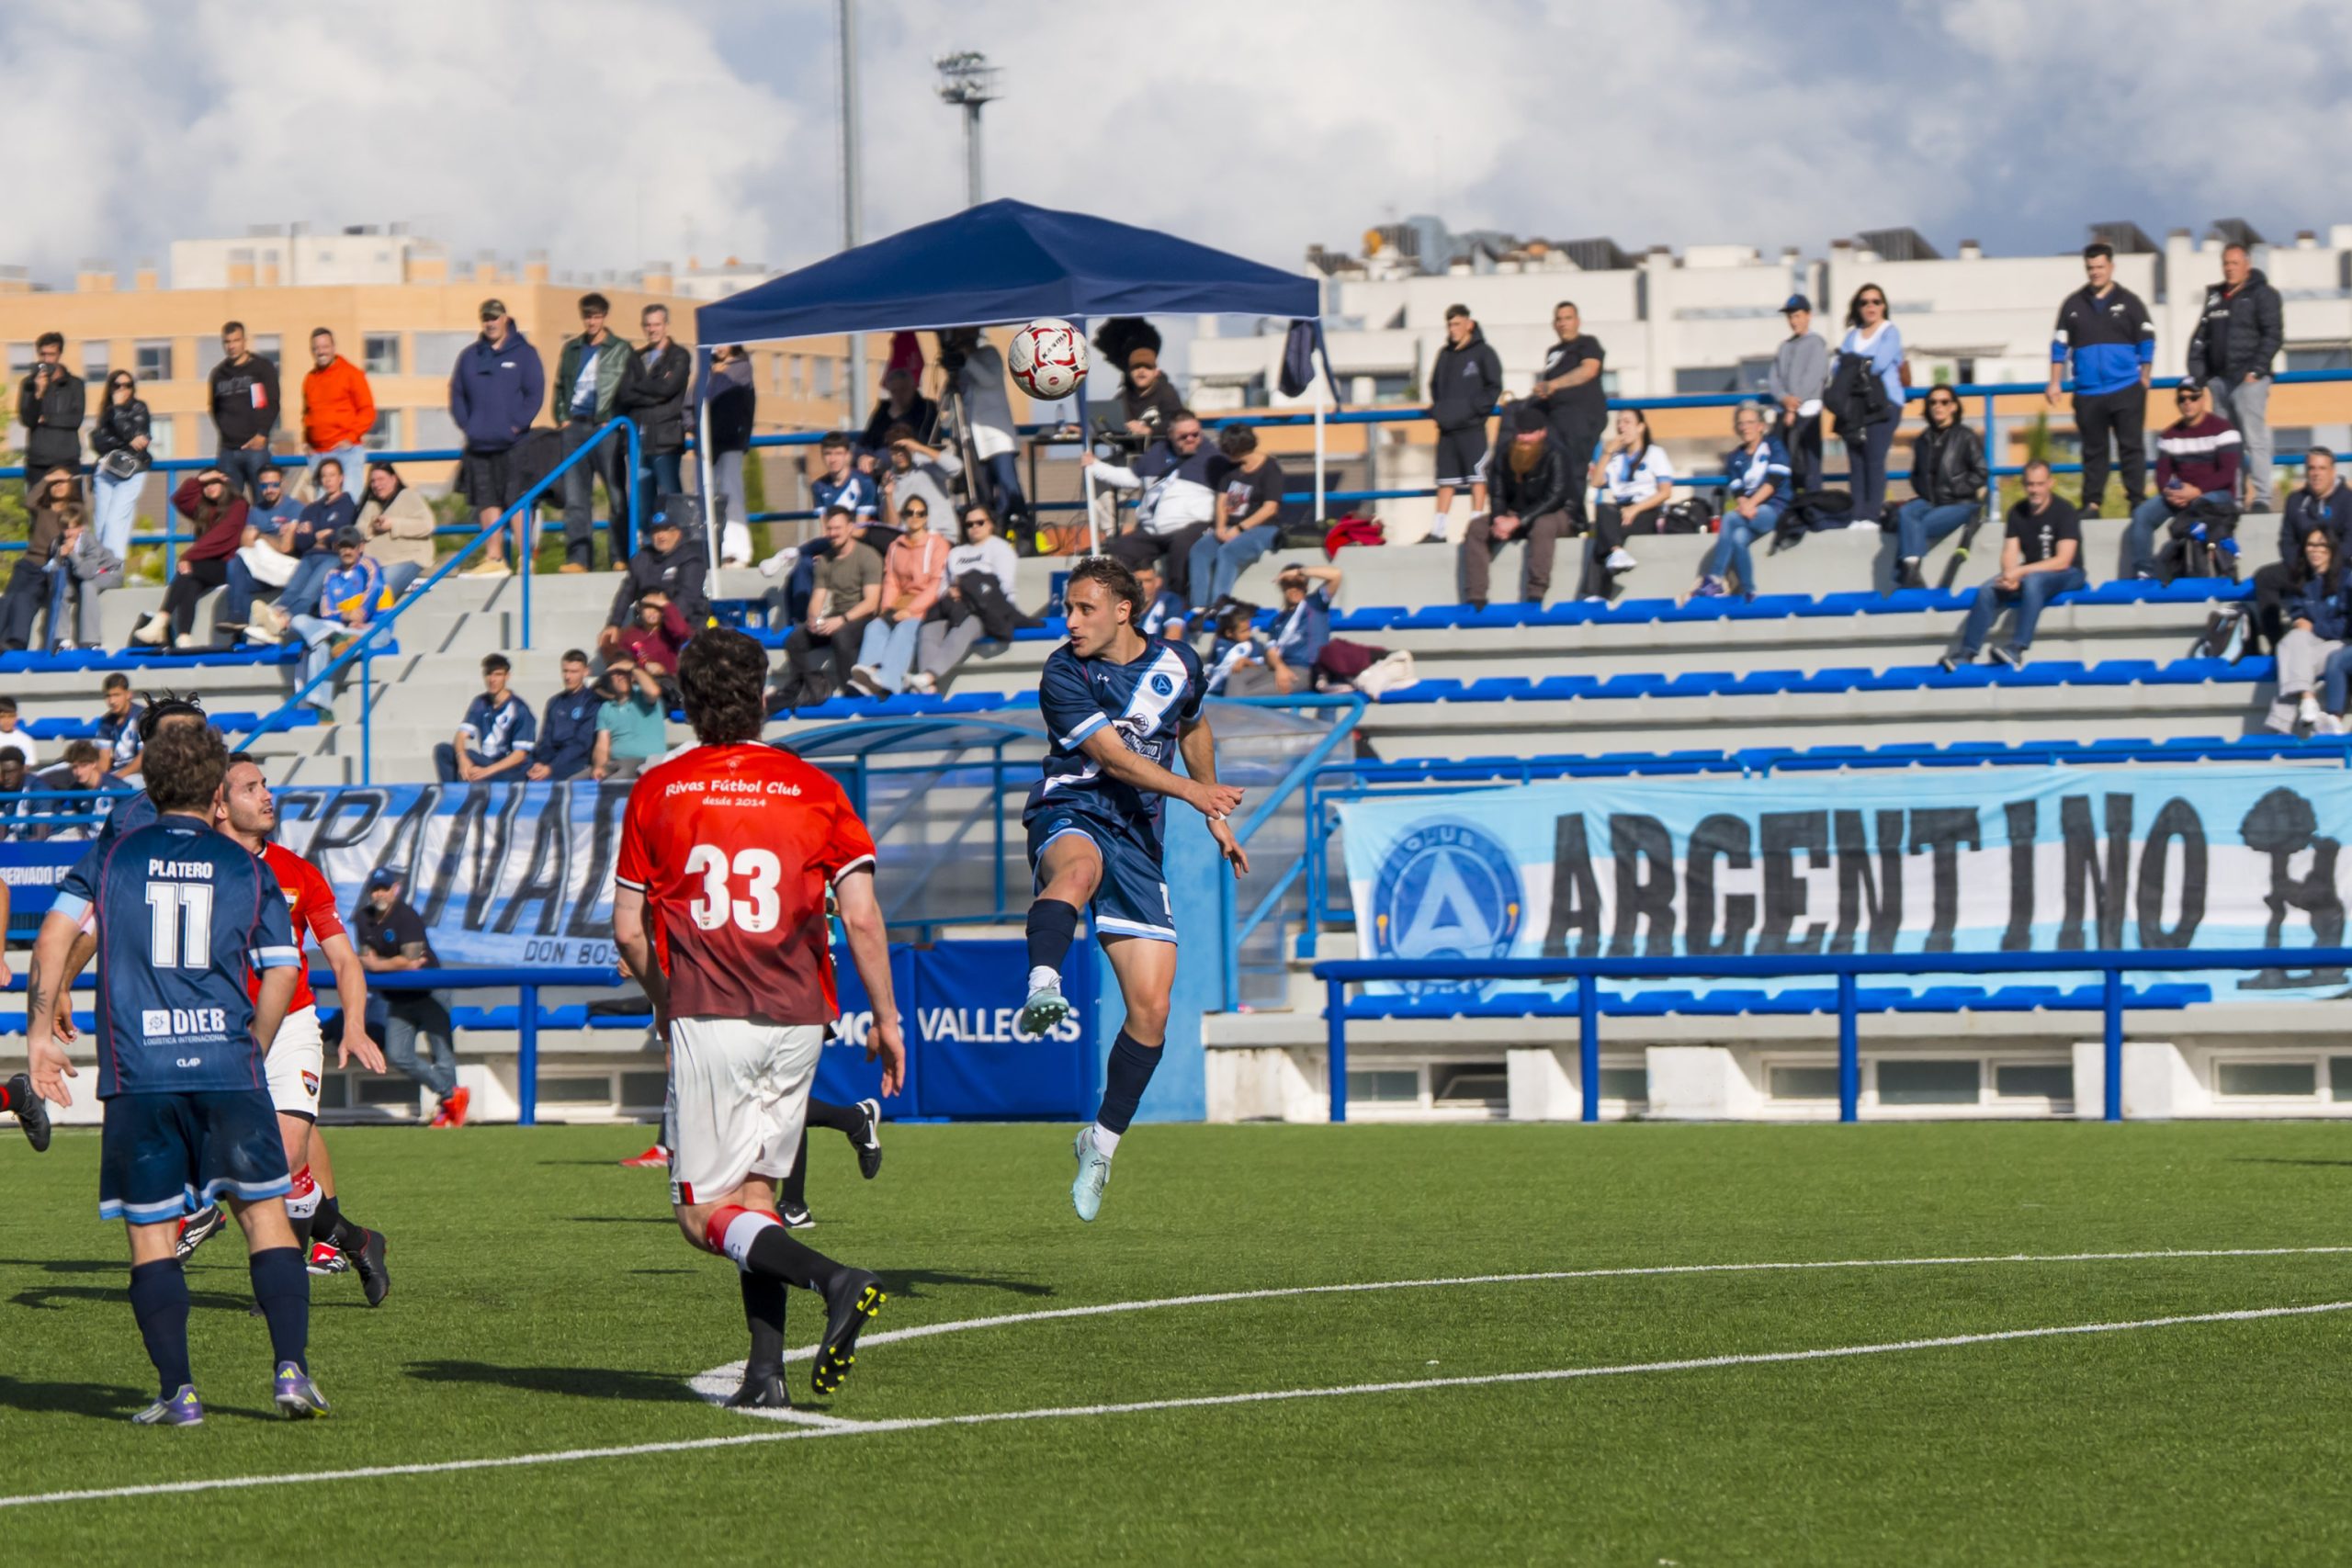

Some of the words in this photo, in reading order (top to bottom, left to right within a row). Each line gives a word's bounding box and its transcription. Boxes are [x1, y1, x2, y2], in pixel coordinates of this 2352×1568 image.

[666, 781, 705, 796] Rivas
[710, 780, 761, 793] Fútbol
[766, 782, 802, 796] Club
[702, 795, 731, 806] desde
[735, 797, 767, 807] 2014
[148, 858, 213, 879] PLATERO
[684, 843, 781, 933] 33
[1540, 792, 2209, 979] ARGENTINO
[145, 881, 213, 969] 11
[523, 940, 568, 964] DON
[172, 1008, 226, 1034] DIEB
[175, 1057, 201, 1067] CLAP
